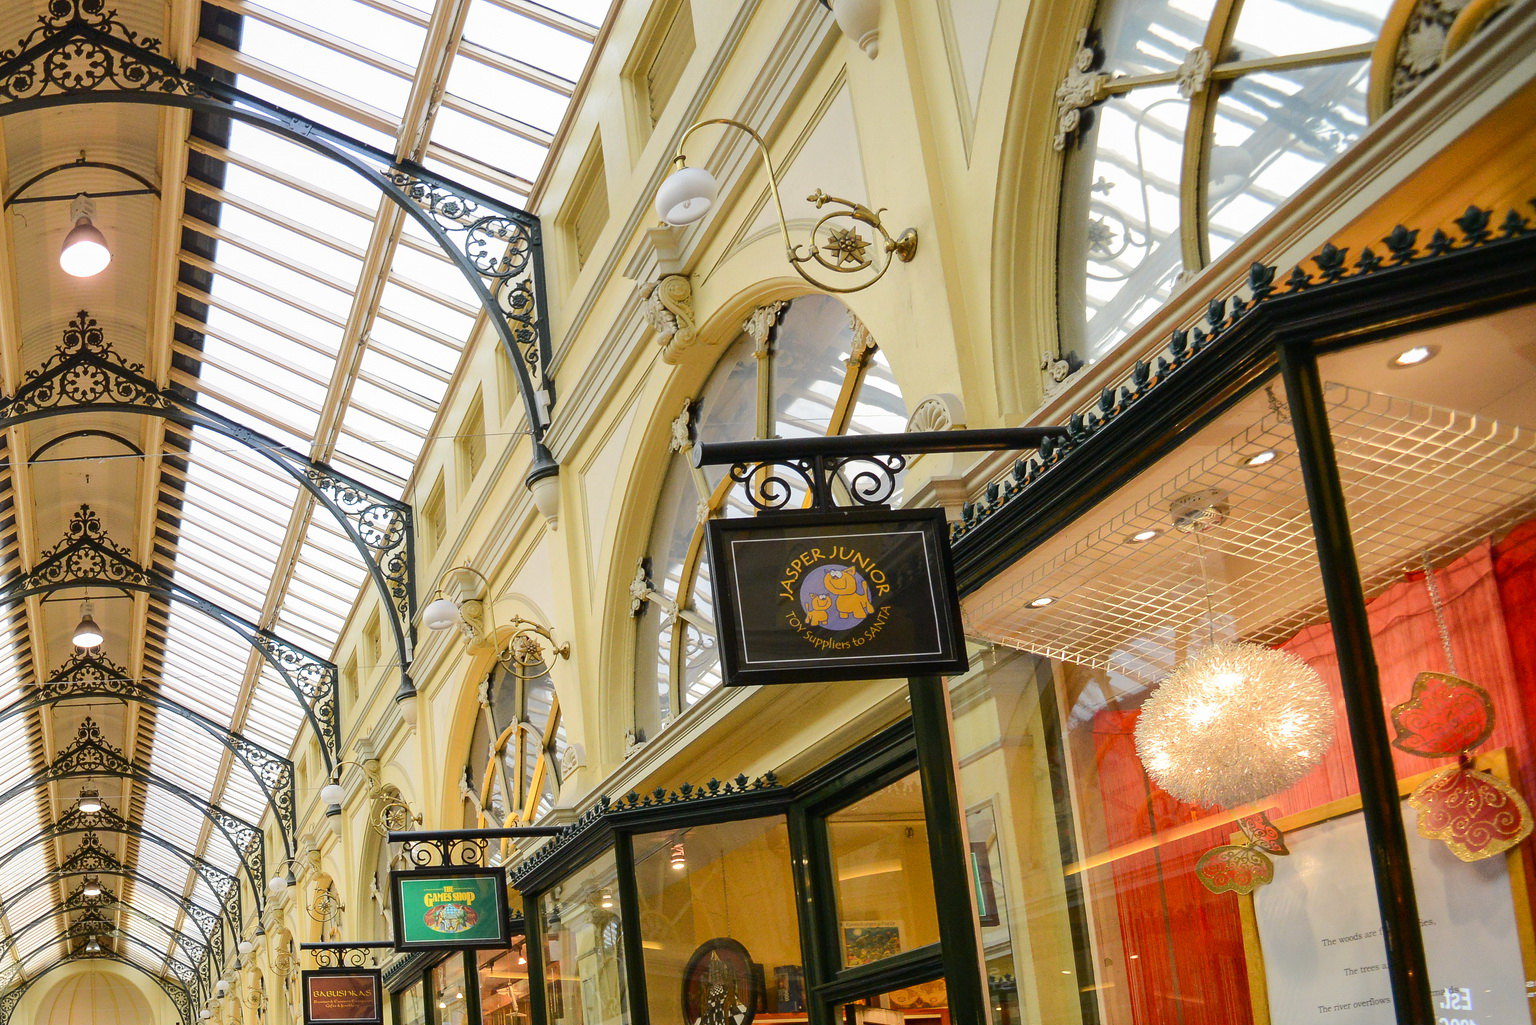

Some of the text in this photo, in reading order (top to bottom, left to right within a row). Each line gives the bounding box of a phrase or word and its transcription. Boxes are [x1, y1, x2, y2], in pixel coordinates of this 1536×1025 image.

[779, 545, 890, 601] JASPER JUNIOR
[785, 604, 892, 651] TOY Suppliers to SANTA
[423, 891, 476, 908] GAMES SHOP
[1321, 930, 1377, 947] The woods are
[1343, 963, 1379, 977] The trees
[1317, 997, 1391, 1014] The river overflows
